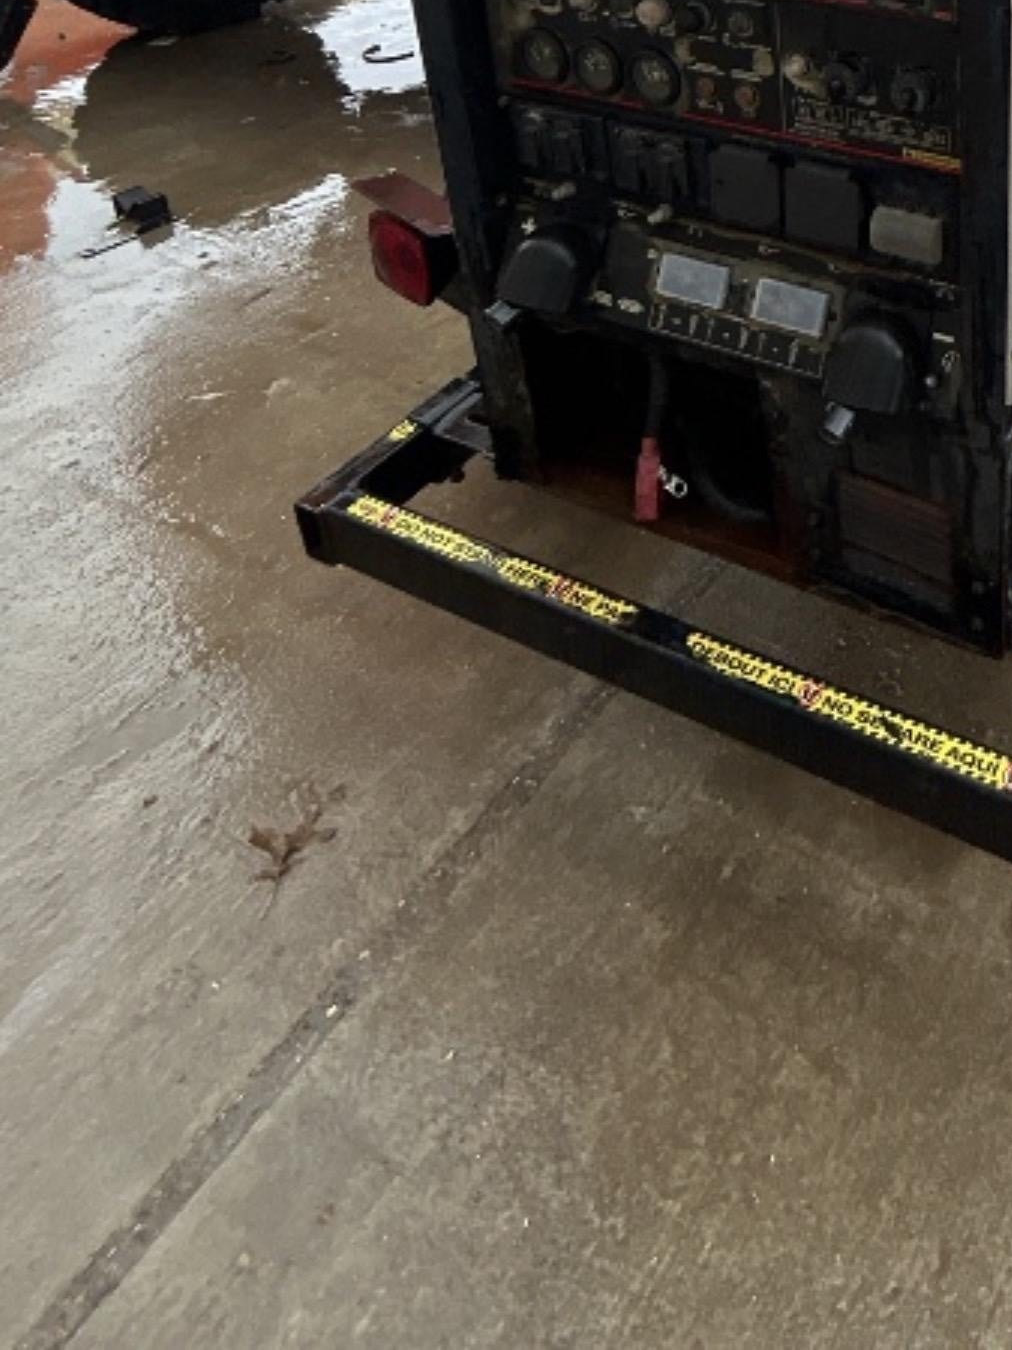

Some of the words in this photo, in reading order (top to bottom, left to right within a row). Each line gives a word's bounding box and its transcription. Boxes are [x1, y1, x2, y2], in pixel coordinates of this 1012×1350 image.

[692, 642, 767, 678] DBOUT
[822, 696, 853, 716] NO
[945, 746, 1000, 776] AQUI
